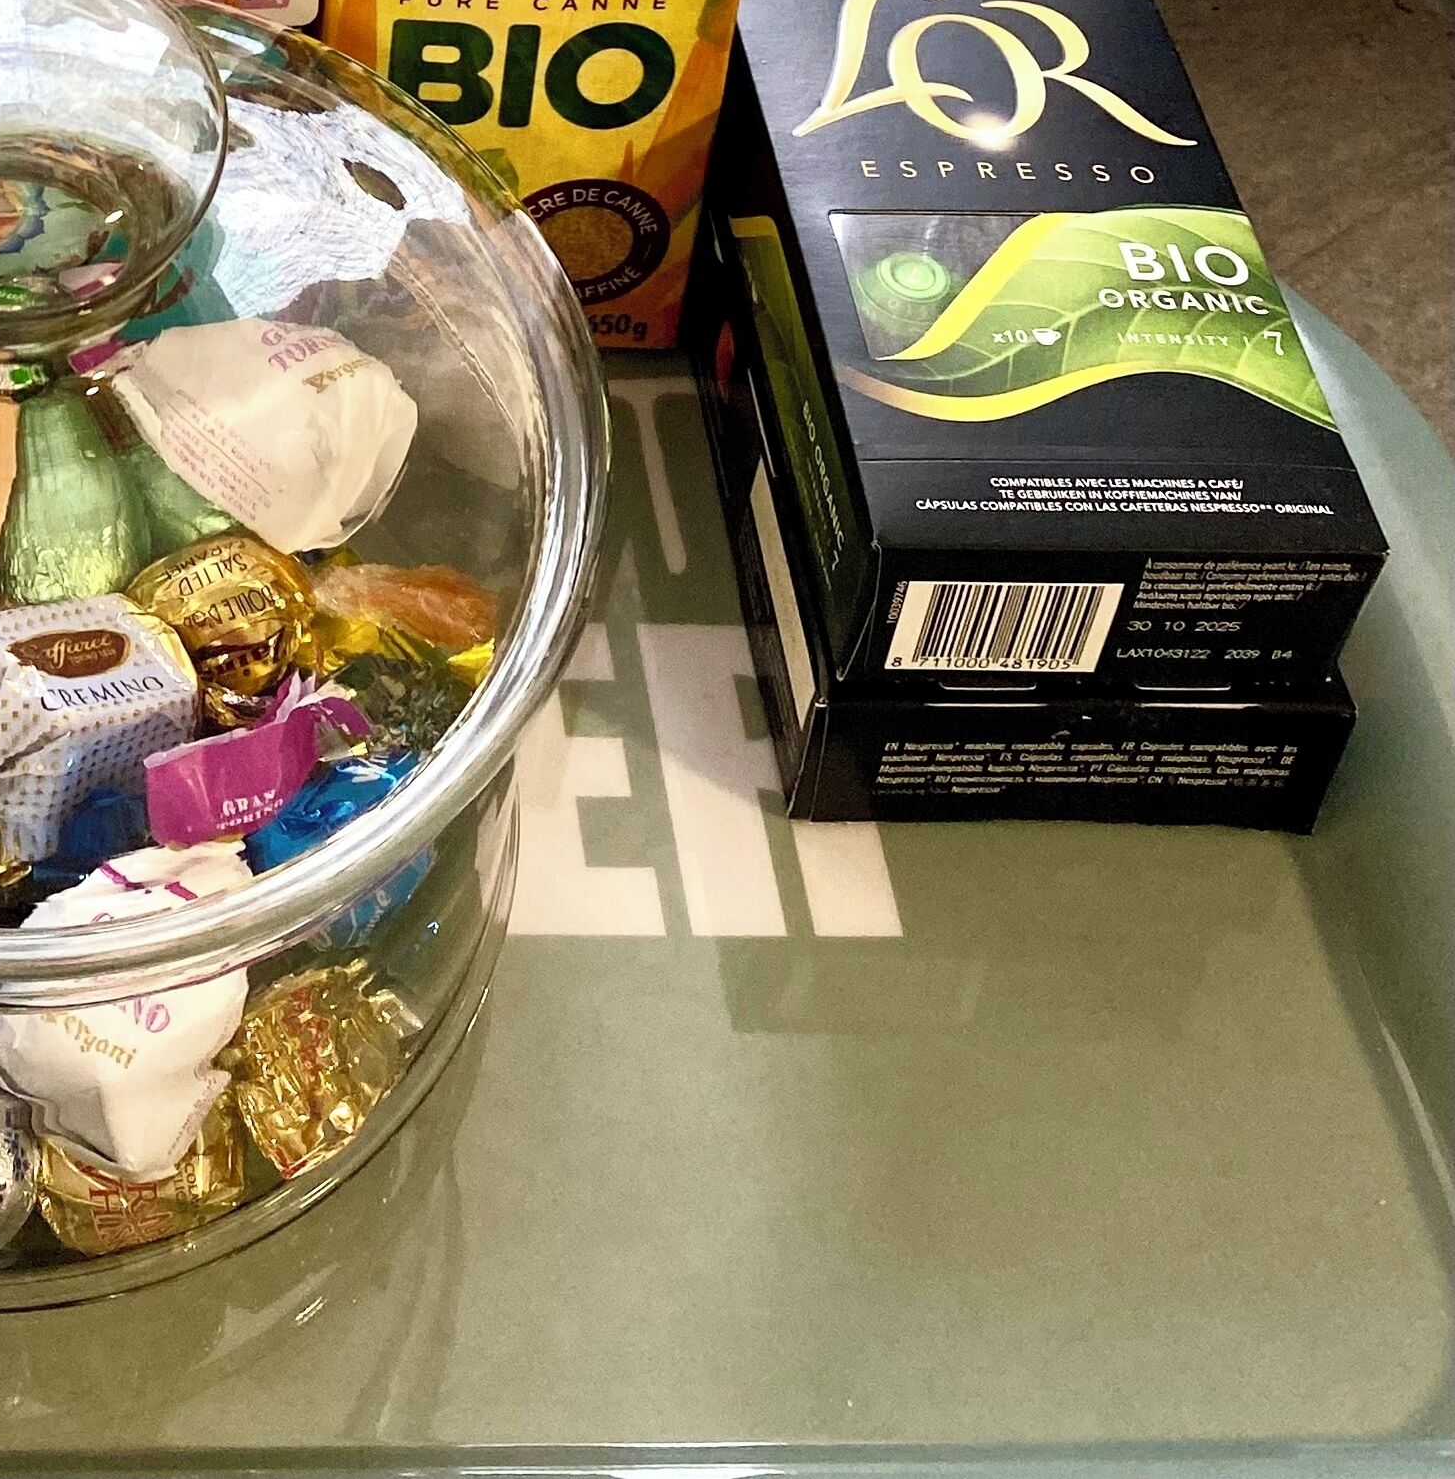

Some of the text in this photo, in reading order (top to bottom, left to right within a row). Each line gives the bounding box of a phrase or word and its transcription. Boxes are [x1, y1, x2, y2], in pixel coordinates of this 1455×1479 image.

[388, 19, 675, 130] BIO
[860, 159, 1155, 185] ESPRESSO
[572, 188, 601, 203] DE
[604, 190, 658, 235] CANNE
[1119, 241, 1249, 286] BIO
[1098, 288, 1270, 315] ORGANIC
[993, 328, 1028, 344] x10
[1117, 330, 1285, 357] INTENSITY 7
[990, 477, 1072, 488] COMPATIBLES
[1075, 478, 1107, 488] AVEC
[1109, 479, 1130, 488] LES
[1132, 479, 1195, 489] MACHINES
[999, 489, 1015, 499] TE
[1017, 489, 1086, 500] GEBRUIKEN
[1088, 491, 1102, 500] IN
[1104, 490, 1210, 501] KOFFIEMACHINES
[915, 498, 978, 510] CÁPSULAS
[979, 500, 1063, 512] COMPATIBLES
[1064, 501, 1093, 512] CON
[1095, 502, 1118, 512] LAS
[1119, 502, 1188, 512] CAFETERAS
[1274, 503, 1334, 515] ORIGINAL
[179, 552, 248, 597] SALTED
[1126, 621, 1242, 632] 30 10 2025
[891, 656, 1071, 670] 8 711000 481905
[221, 789, 276, 817] GRAN
